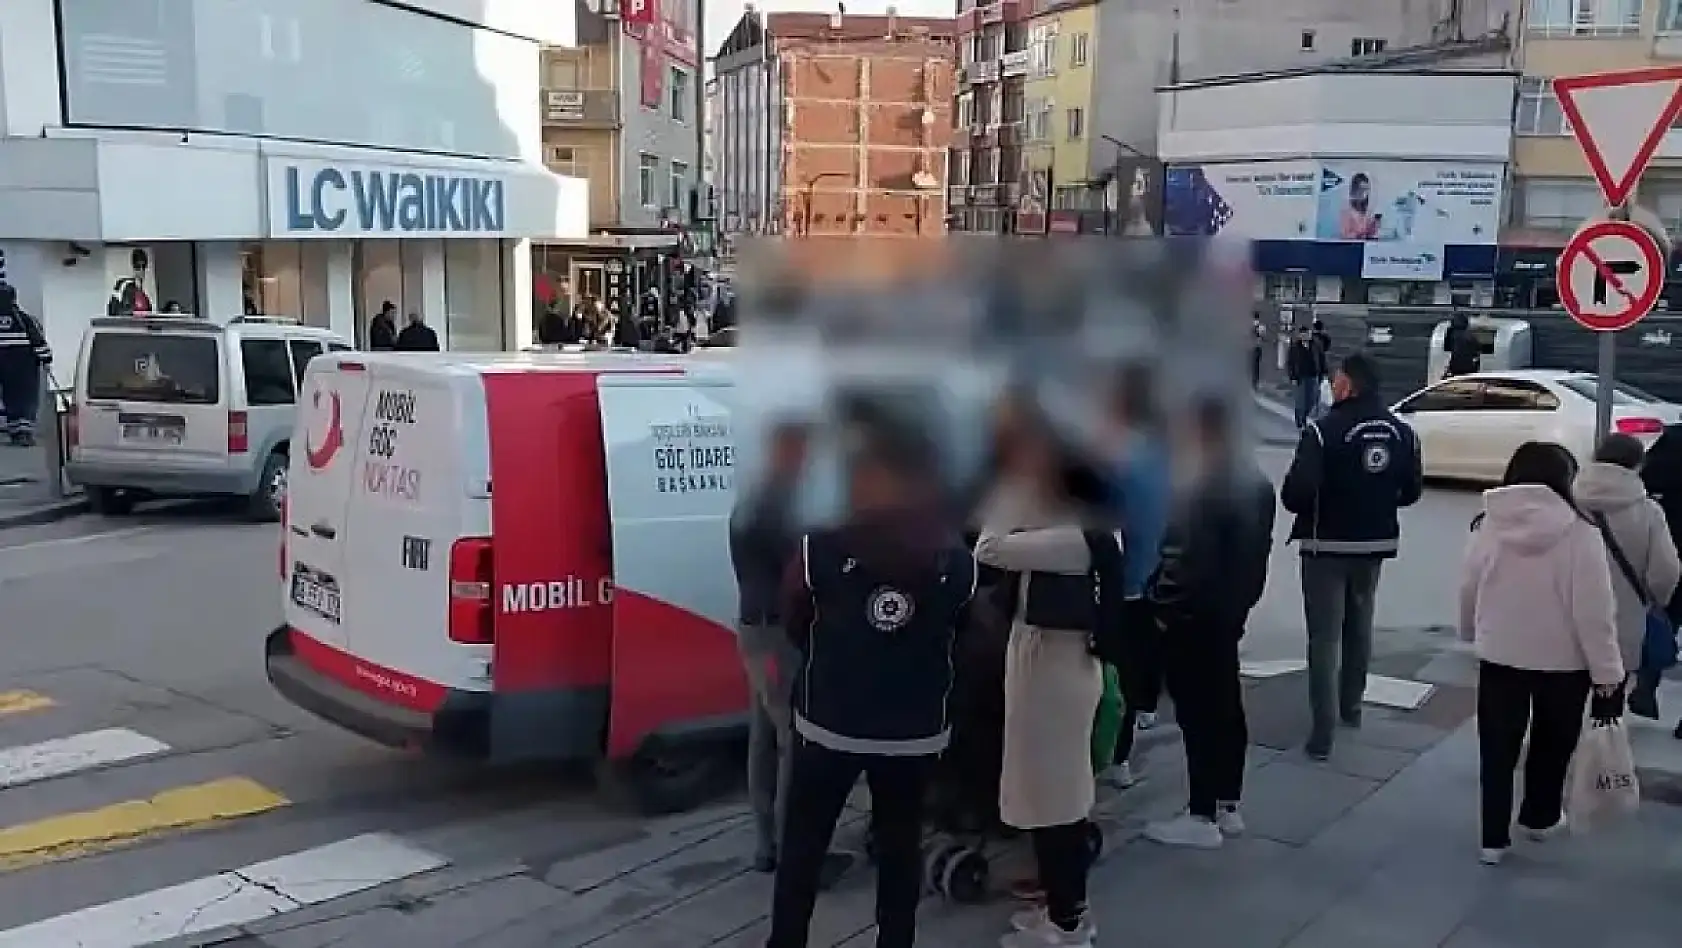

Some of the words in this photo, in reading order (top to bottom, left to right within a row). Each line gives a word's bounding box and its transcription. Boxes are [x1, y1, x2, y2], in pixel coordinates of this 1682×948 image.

[287, 165, 347, 231] LC
[369, 423, 397, 460] GÖÇ
[655, 443, 685, 472] GÖÇ
[502, 574, 590, 613] MOBİL
